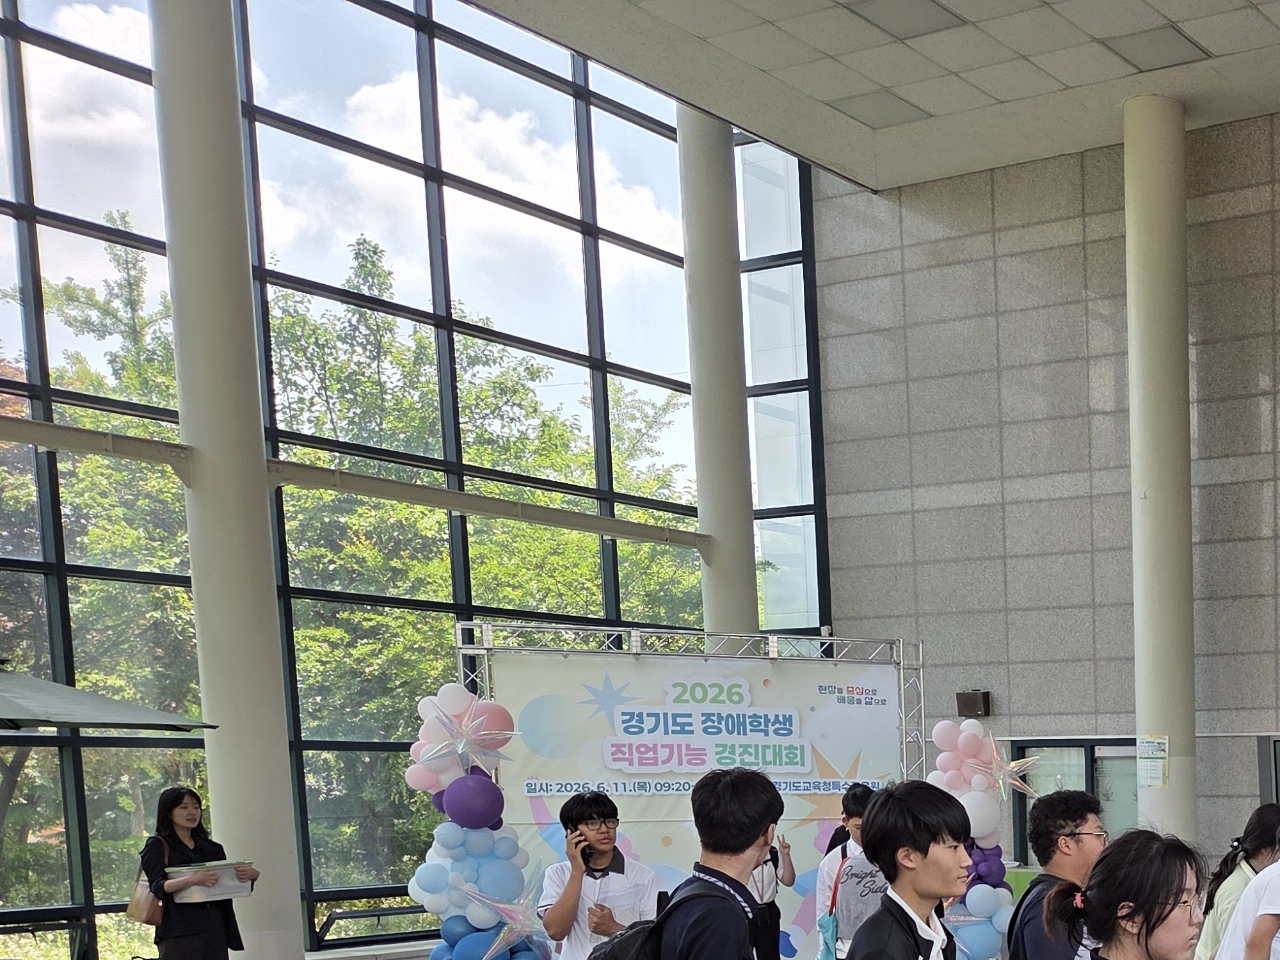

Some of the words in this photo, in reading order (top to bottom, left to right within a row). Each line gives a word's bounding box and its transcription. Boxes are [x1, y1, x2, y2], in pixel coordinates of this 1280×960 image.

[671, 682, 745, 705] 2026
[620, 711, 695, 736] 경기도
[700, 711, 794, 738] 장애학생
[610, 742, 708, 767] 직업기능
[714, 742, 806, 768] 경진대회
[525, 782, 553, 794] 일시:
[614, 781, 652, 794] 11.(목)
[774, 780, 880, 792] 경기도교육청특수원
[839, 865, 880, 886] Bright
